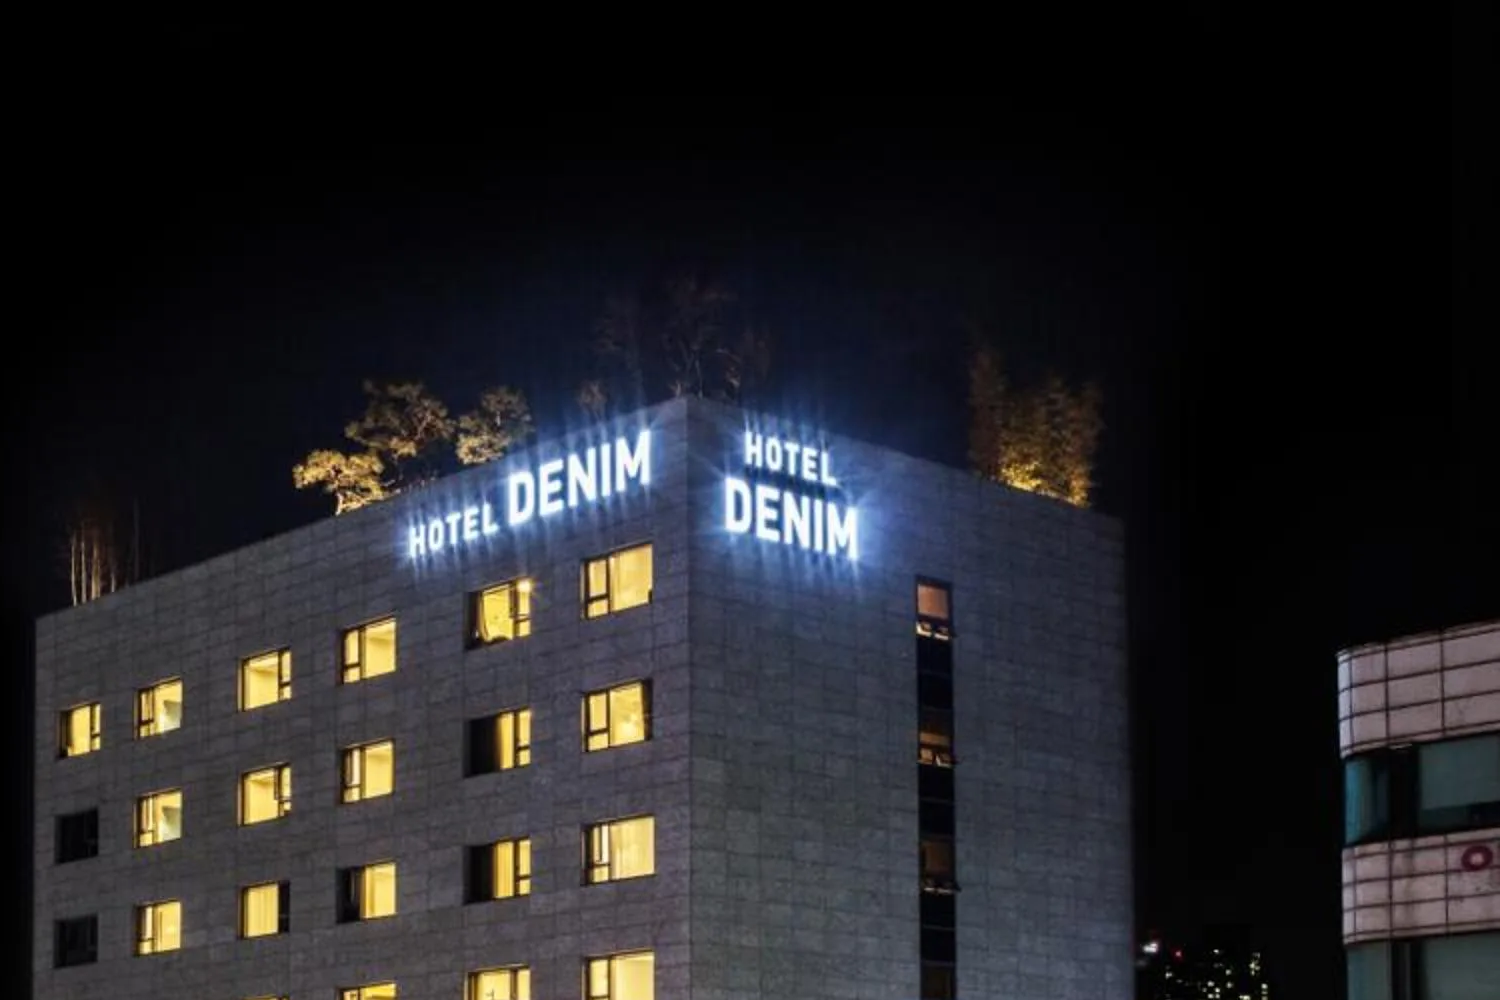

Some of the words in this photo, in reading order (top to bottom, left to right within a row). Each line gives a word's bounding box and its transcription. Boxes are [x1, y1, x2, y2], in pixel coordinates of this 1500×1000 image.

[408, 503, 499, 559] HOTEL
[507, 429, 651, 527] DENIM
[744, 431, 838, 486] HOTEL
[724, 476, 859, 561] DENIM
